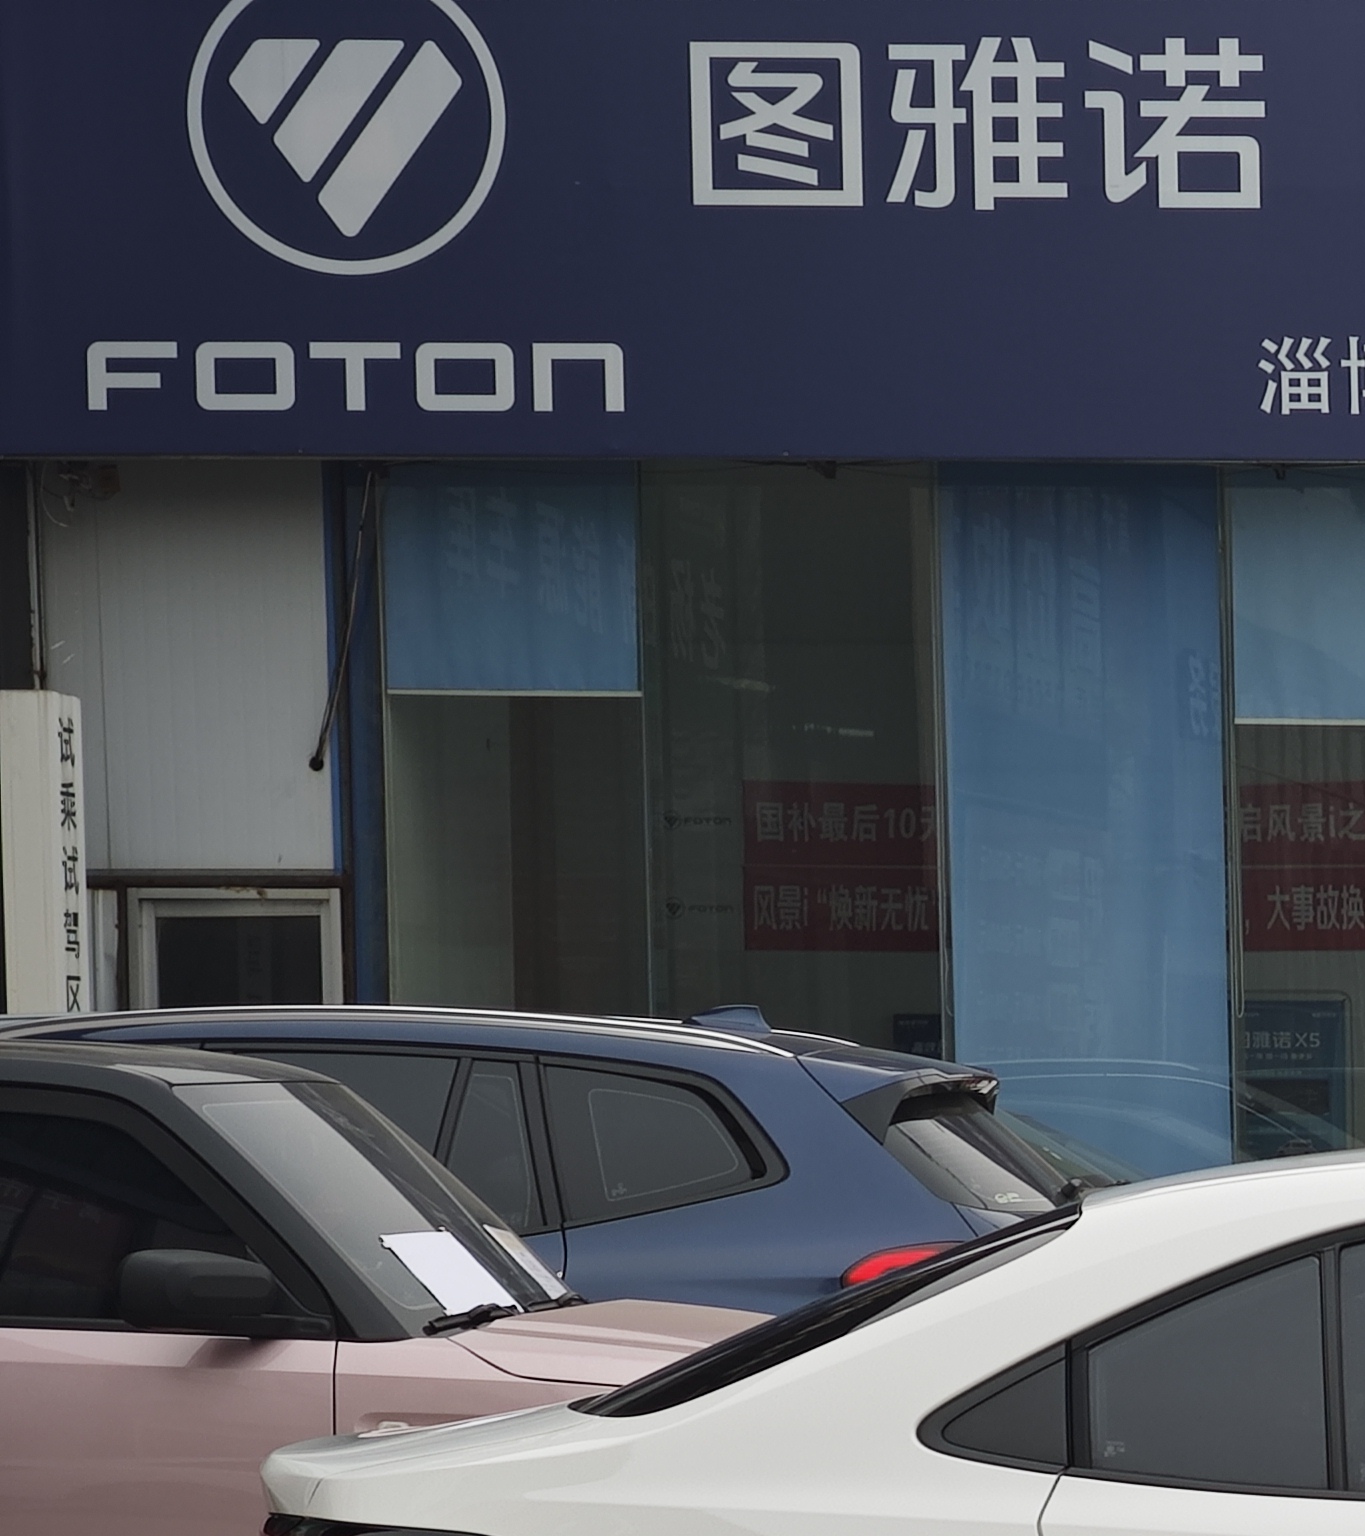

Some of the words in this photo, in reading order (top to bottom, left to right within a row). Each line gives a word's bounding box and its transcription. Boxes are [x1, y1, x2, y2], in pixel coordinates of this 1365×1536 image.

[688, 36, 1267, 211] 图雅诺
[86, 340, 626, 412] FOTON
[57, 717, 82, 1012] 试乘试驾区
